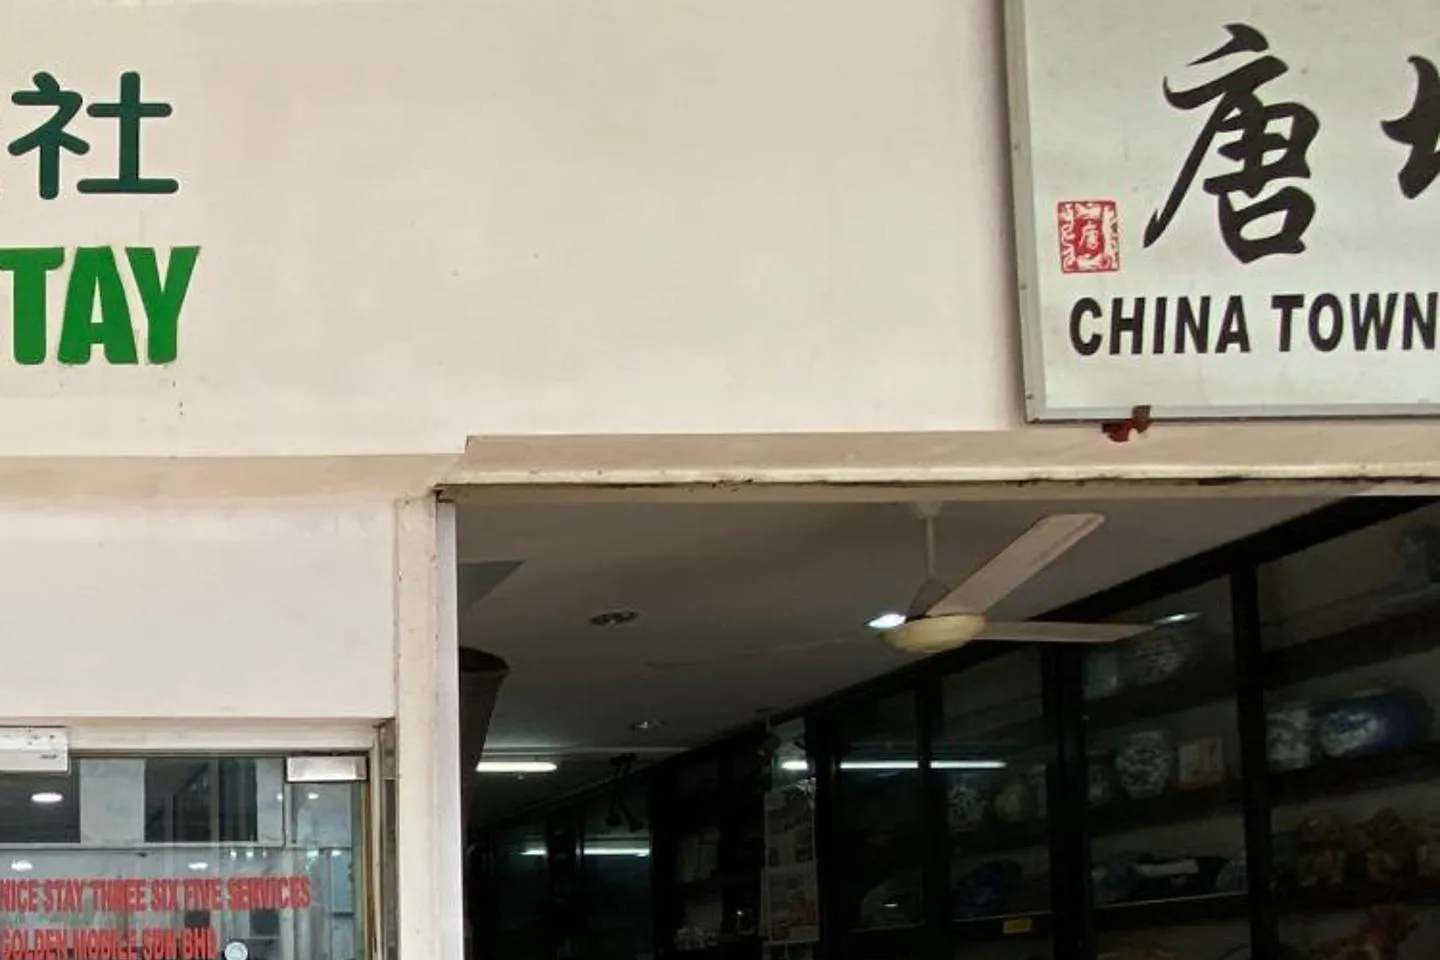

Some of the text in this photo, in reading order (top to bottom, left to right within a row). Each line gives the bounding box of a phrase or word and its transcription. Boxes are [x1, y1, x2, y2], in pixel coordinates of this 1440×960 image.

[1069, 291, 1440, 356] CHINA TOWN
[183, 927, 217, 960] BHD
